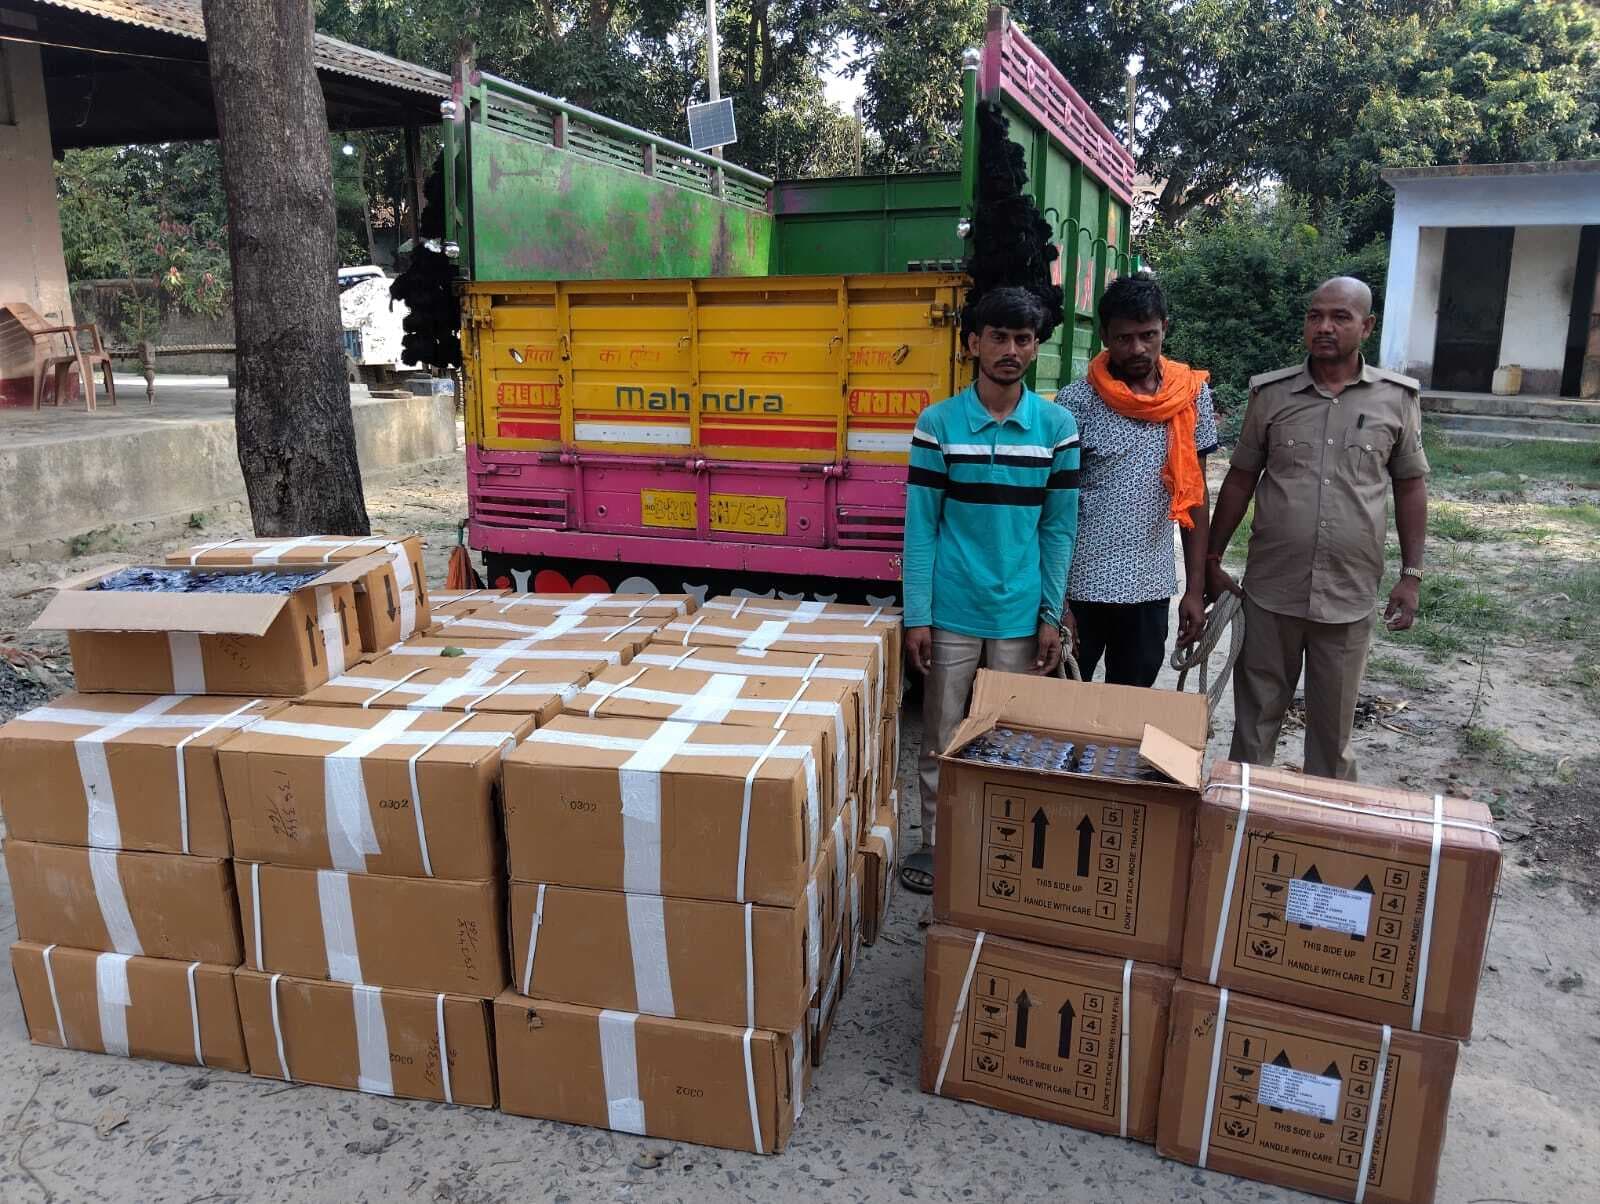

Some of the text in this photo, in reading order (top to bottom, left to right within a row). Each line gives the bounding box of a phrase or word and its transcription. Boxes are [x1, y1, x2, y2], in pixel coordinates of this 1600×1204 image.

[857, 391, 921, 415] HORN
[1109, 811, 1118, 822] 5
[1106, 835, 1115, 846] 4
[1105, 857, 1114, 869] 3
[1124, 807, 1141, 930] DON'T STACK MORE THAN FIVE
[1036, 878, 1052, 889] THIS
[1053, 881, 1071, 892] SIDE
[1392, 873, 1402, 885] 5
[1103, 881, 1112, 893] 2
[1024, 896, 1091, 916] HANDLE WITH CARE
[1387, 897, 1399, 909] 4
[1416, 890, 1425, 914] THAN
[1103, 905, 1109, 915] 1
[1384, 922, 1395, 934] 3
[1411, 918, 1422, 941] MORE
[1303, 941, 1356, 958] THIS SIDE UP
[1380, 948, 1391, 959] 2
[1406, 944, 1417, 973] STACK
[1288, 960, 1365, 983] HANDLE WITH CARE
[1377, 973, 1385, 983] 1
[1402, 974, 1411, 1000] DON'T
[1088, 998, 1098, 1008] 5
[1086, 1020, 1096, 1031] 4
[1111, 1015, 1119, 1034] THAN
[1085, 1042, 1094, 1052] 3
[1107, 1035, 1116, 1061] MORE
[1019, 1056, 1063, 1072] THIS SIDE UP
[1083, 1064, 1092, 1074] 2
[1358, 1060, 1368, 1071] 5
[1105, 1061, 1114, 1086] STACK
[1008, 1073, 1072, 1096] HANDLE WITH CARE
[1354, 1084, 1365, 1095] 4
[1082, 1086, 1089, 1096] 1
[1351, 1107, 1361, 1118] 3
[1274, 1121, 1325, 1139] THIS SIDE UP
[1348, 1130, 1358, 1142] 2
[1259, 1140, 1333, 1163] HANDLE WITH CARE
[1345, 1154, 1353, 1164] 1
